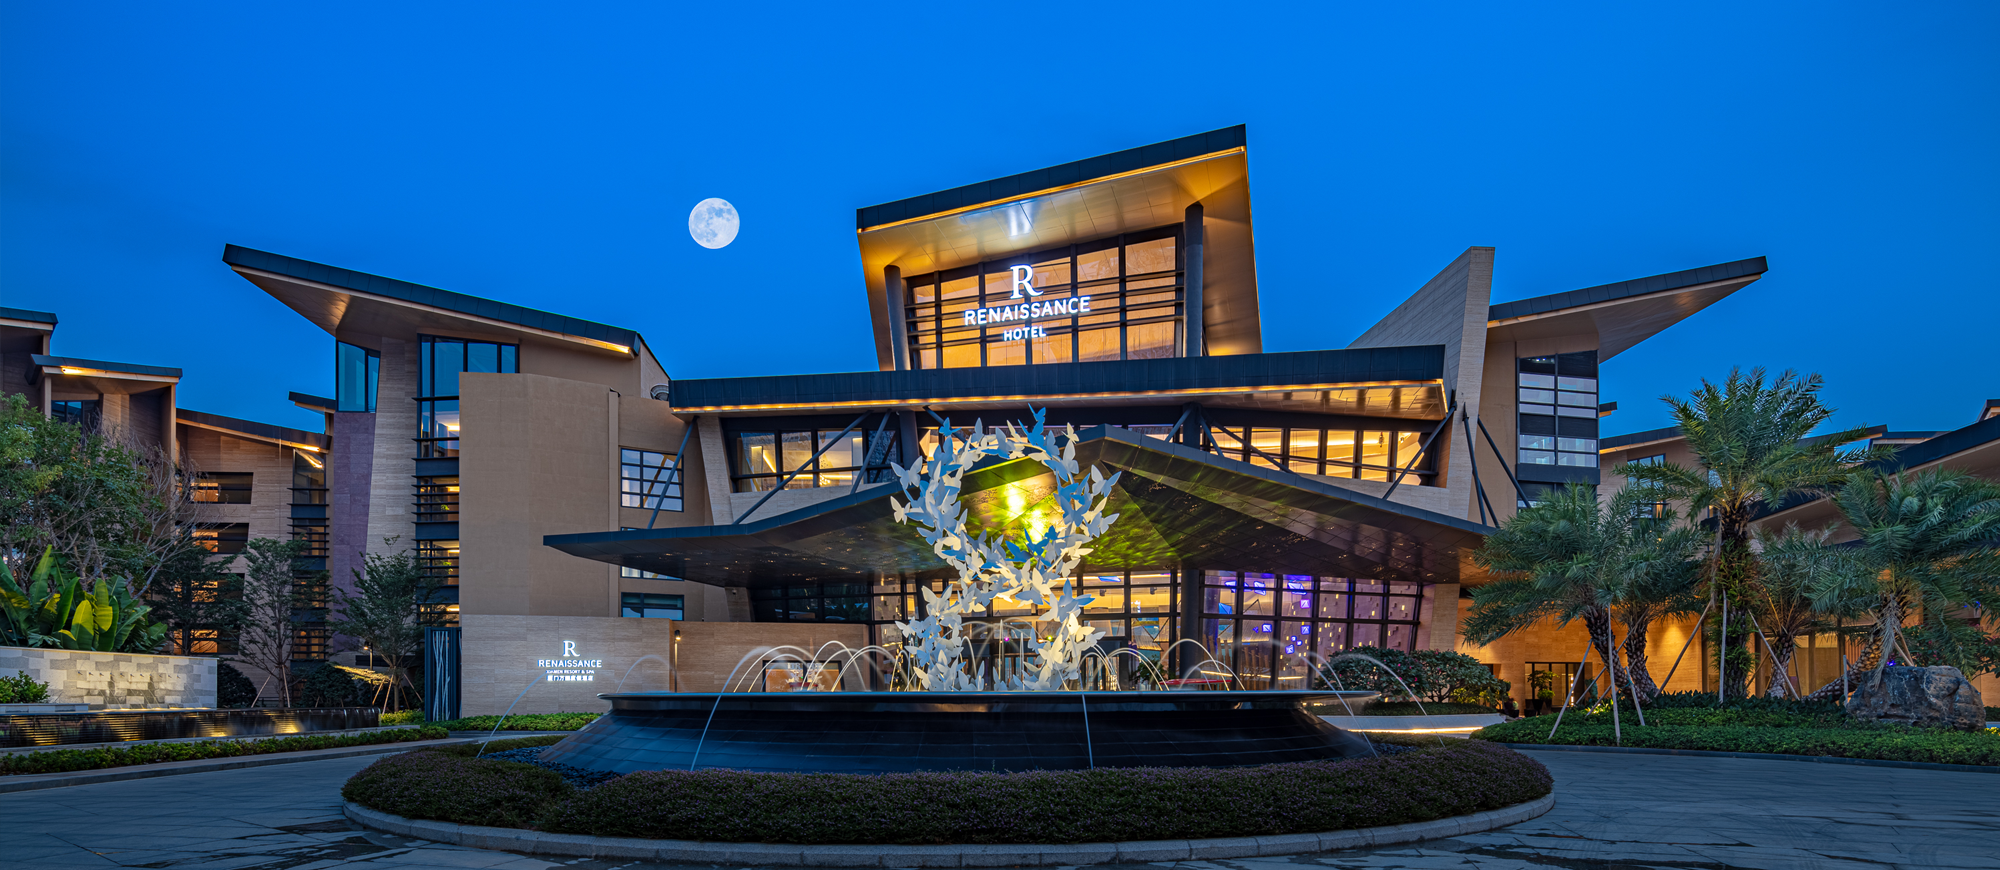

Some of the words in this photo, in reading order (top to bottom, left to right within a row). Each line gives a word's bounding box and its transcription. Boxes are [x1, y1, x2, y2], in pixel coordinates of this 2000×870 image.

[1010, 264, 1044, 300] R
[964, 296, 1091, 326] RENAISSANCE
[1003, 325, 1047, 342] HOTEL
[562, 640, 581, 657] R
[538, 659, 602, 668] RENAISSANCE
